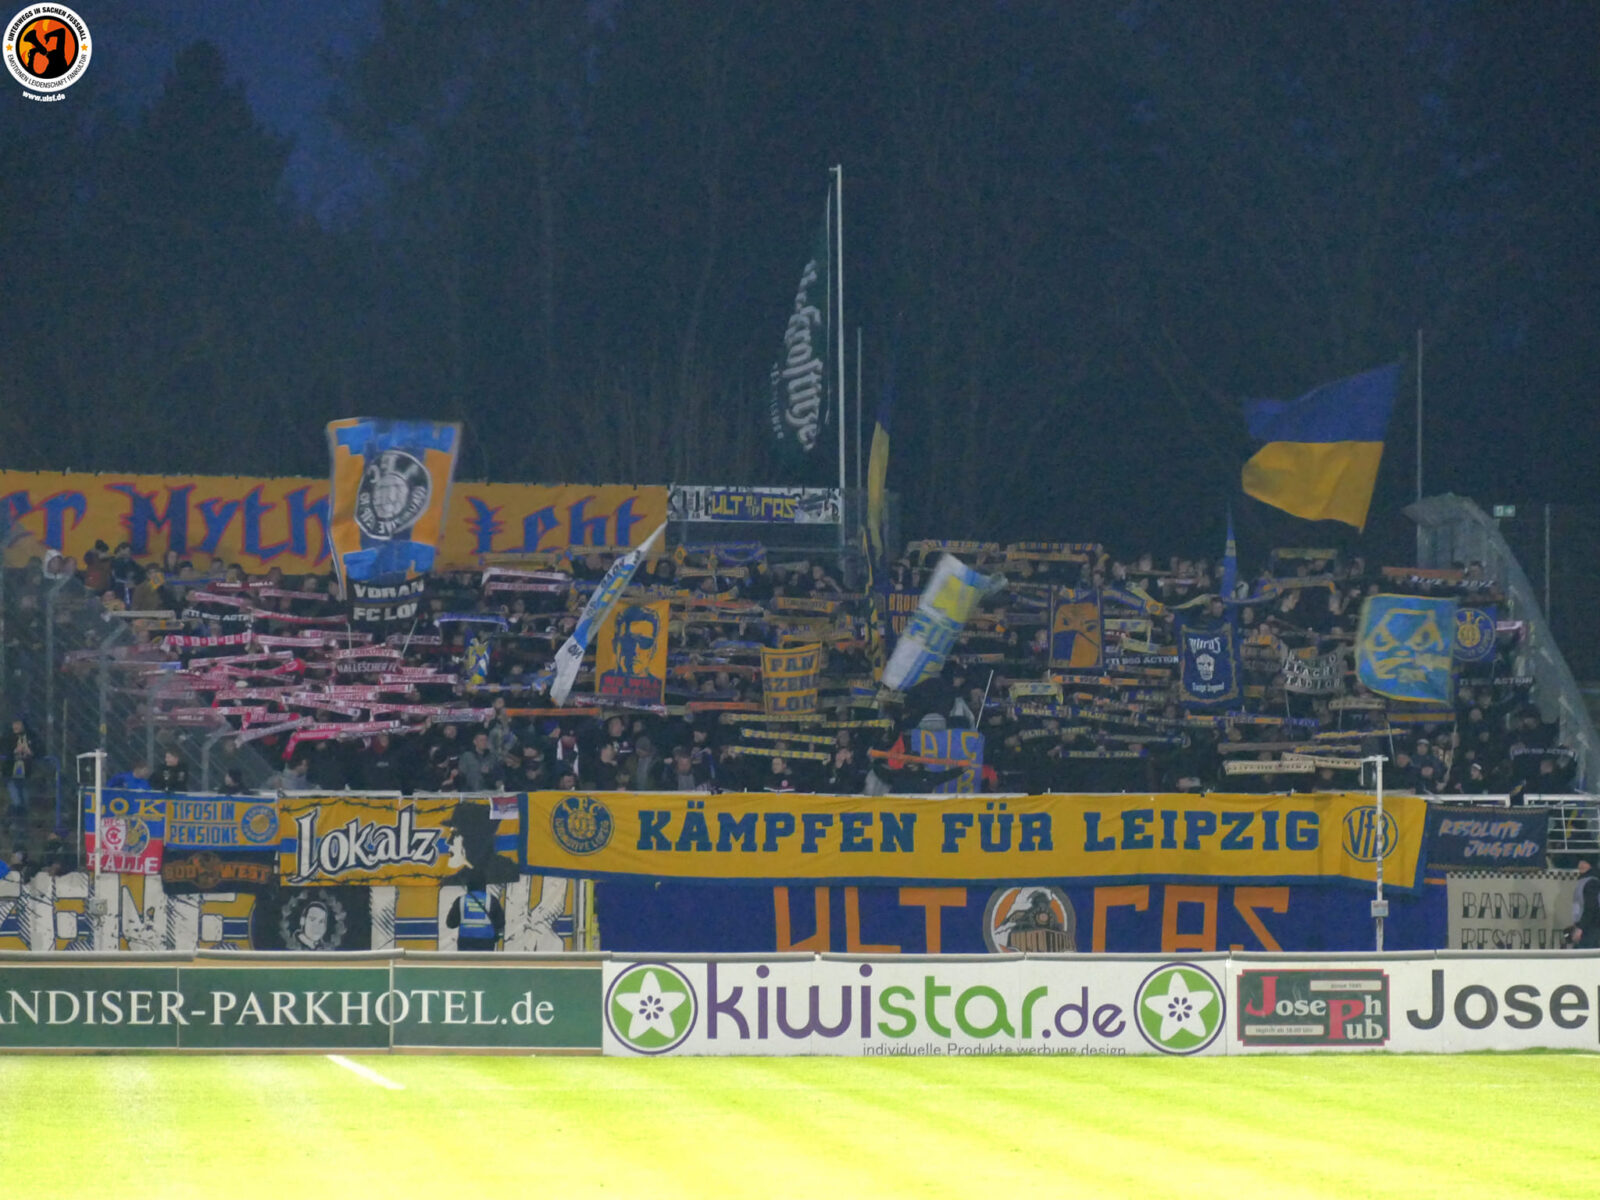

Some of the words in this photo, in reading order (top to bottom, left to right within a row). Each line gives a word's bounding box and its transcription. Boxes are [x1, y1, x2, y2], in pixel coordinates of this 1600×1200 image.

[353, 579, 425, 599] VORAN
[353, 606, 382, 622] FC
[173, 801, 216, 821] TIFOSI
[221, 801, 235, 821] IN
[170, 824, 238, 844] PENSIONE
[637, 801, 917, 853] KÄMPFEN
[942, 802, 1053, 853] FÜR
[1084, 808, 1319, 852] LEIPZIG
[1439, 818, 1523, 838] RESOLUTE
[287, 804, 442, 884] Lokalz
[1463, 840, 1539, 858] JUGEND
[1462, 891, 1547, 919] BANDA
[0, 989, 555, 1026] NDISER-PARKHOTEL.de
[706, 963, 1127, 1040] kiwistar.de
[1406, 969, 1600, 1034] Jose
[863, 1042, 941, 1056] individuelle
[948, 1042, 1013, 1056] Produkte
